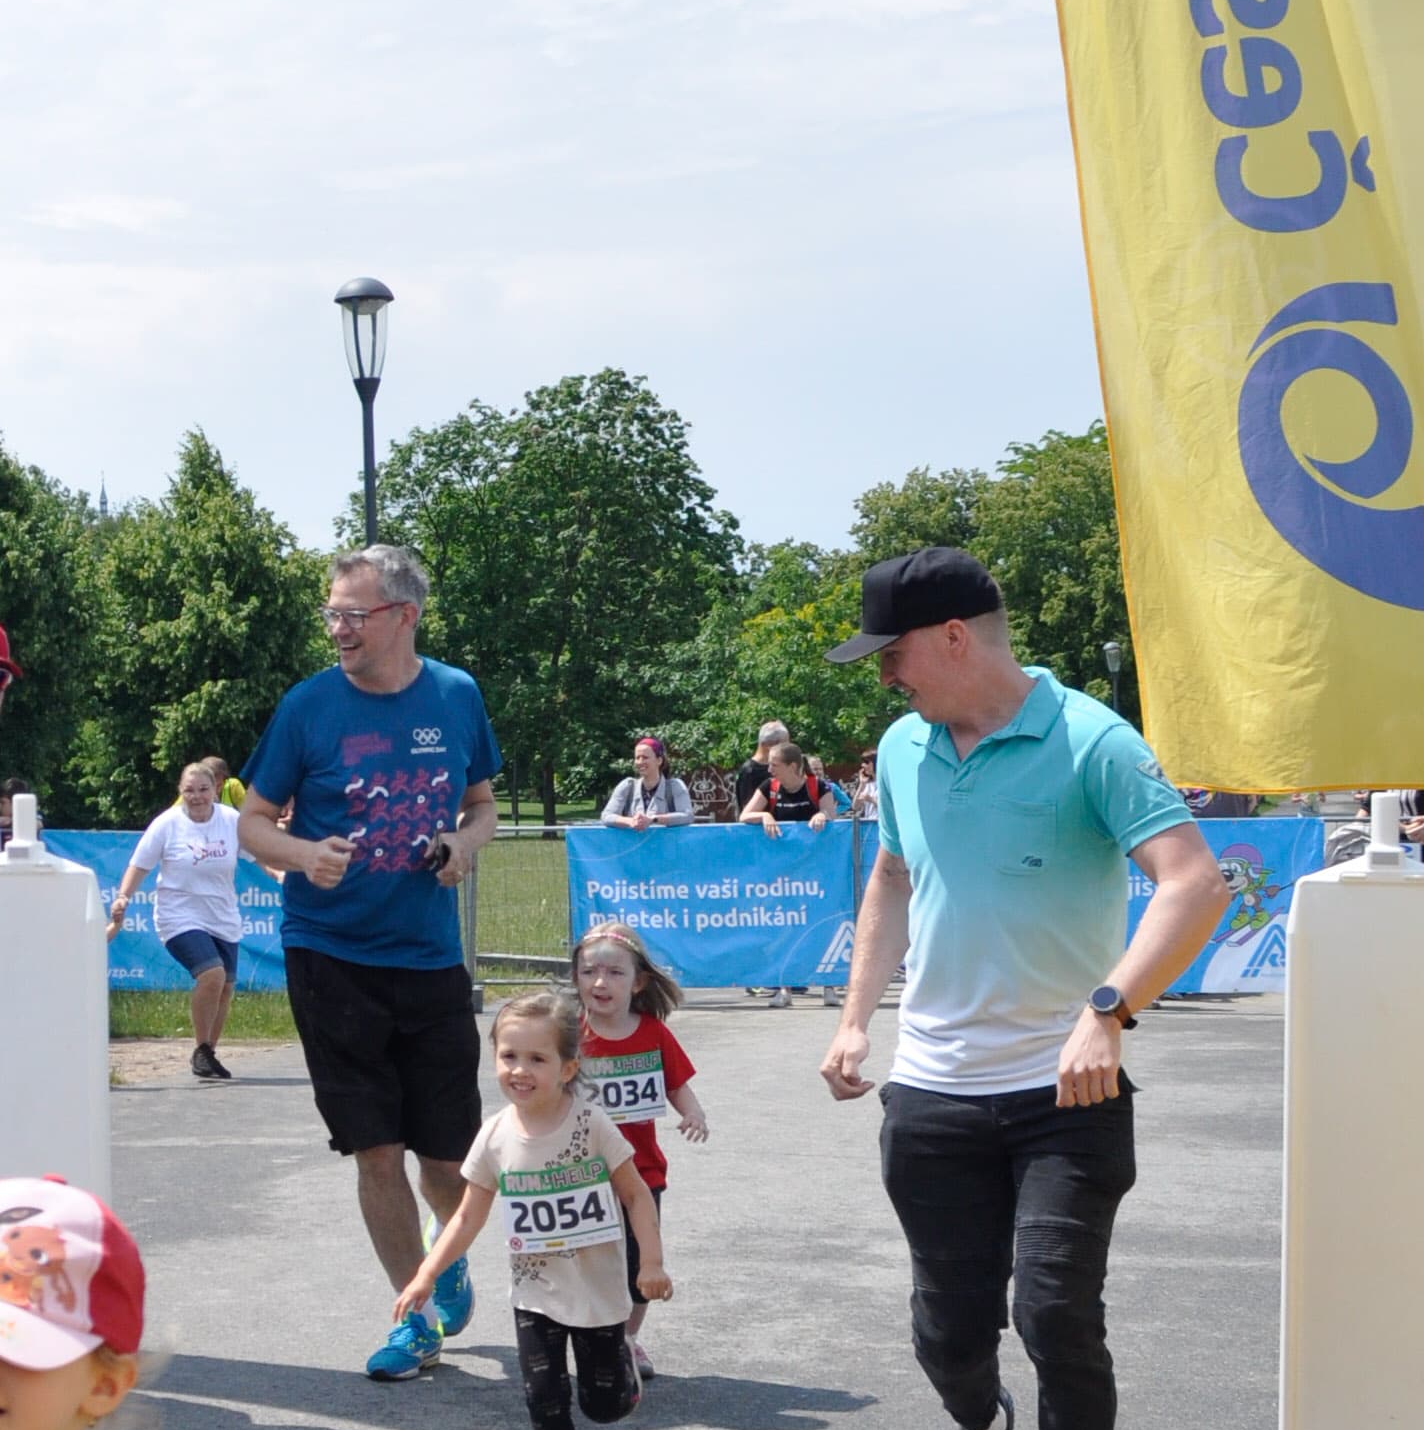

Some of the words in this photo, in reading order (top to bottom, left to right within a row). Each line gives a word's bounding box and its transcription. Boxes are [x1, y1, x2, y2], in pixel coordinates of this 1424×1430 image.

[587, 879, 689, 903] Pojistíme
[695, 878, 739, 899] vaši
[745, 877, 825, 899] rodinu,
[696, 905, 807, 932] podnikání
[553, 1162, 602, 1188] HELP
[510, 1191, 606, 1233] 2054
